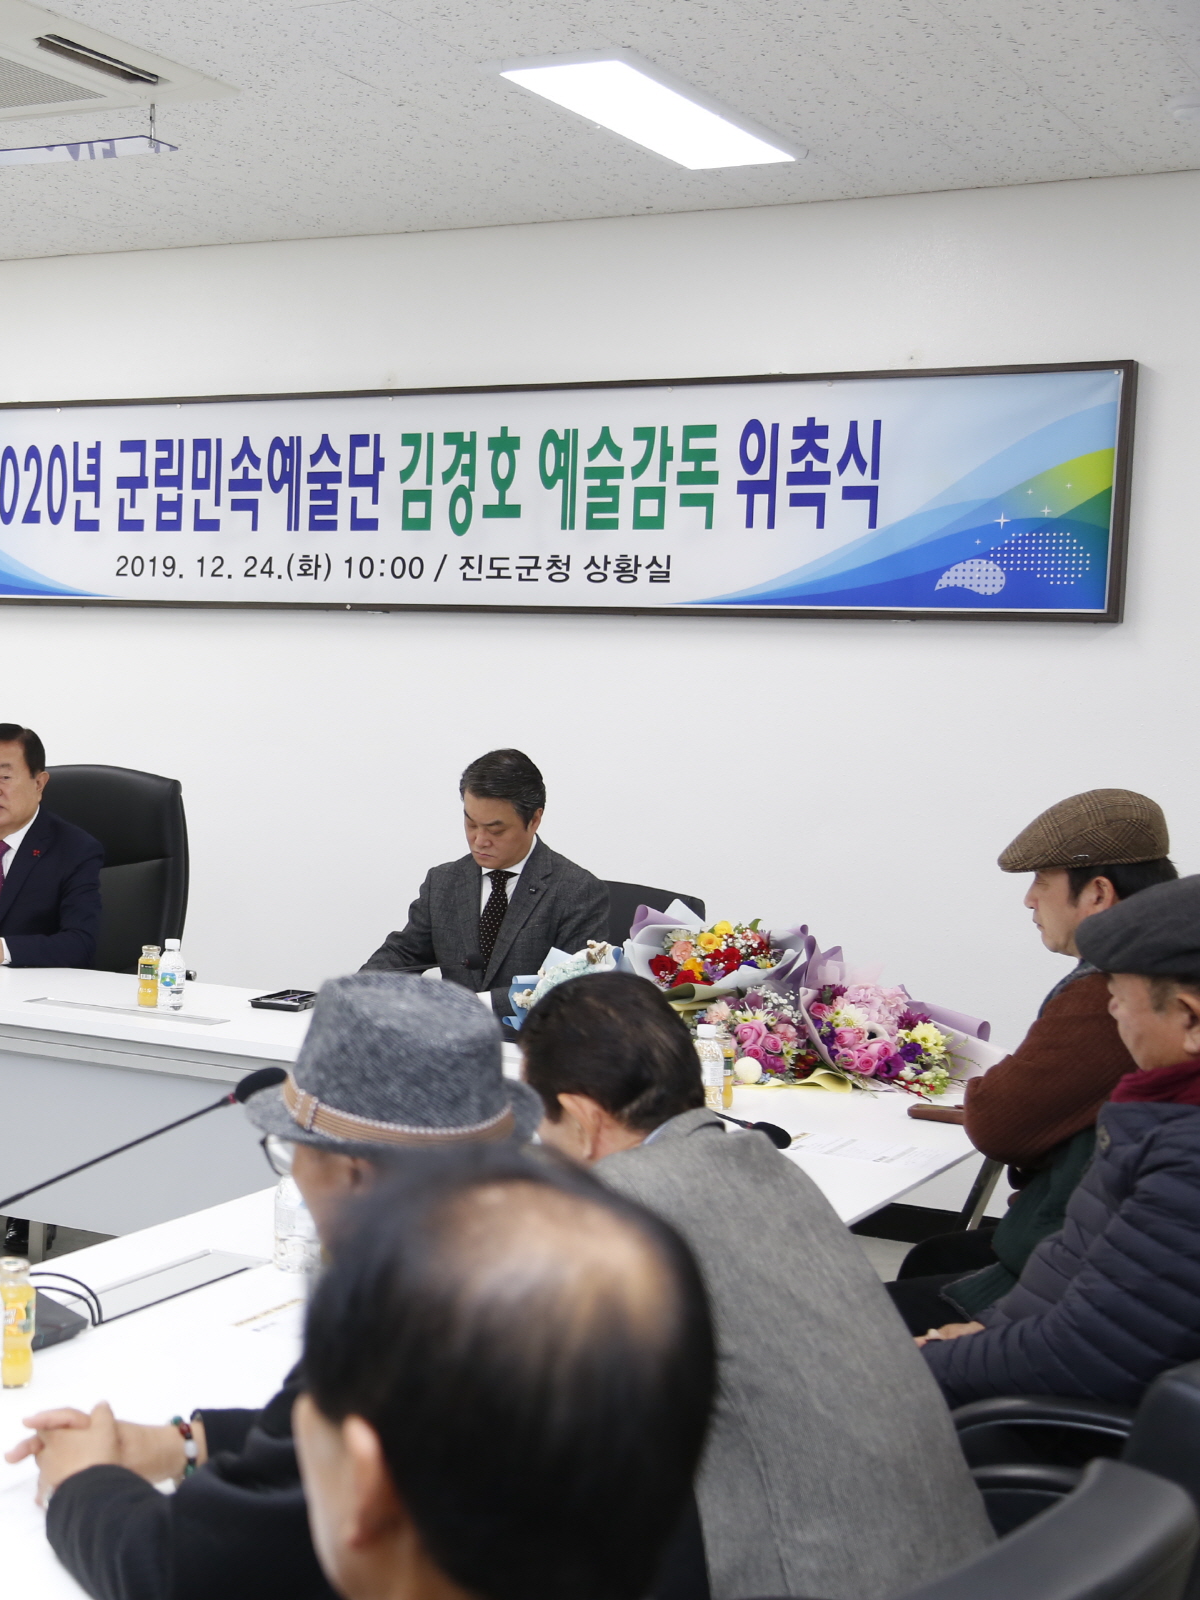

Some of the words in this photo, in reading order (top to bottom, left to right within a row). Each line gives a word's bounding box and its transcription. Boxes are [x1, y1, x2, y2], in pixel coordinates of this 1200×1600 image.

[116, 433, 386, 533] 군립민속예술단
[399, 426, 522, 538] 김경호
[538, 425, 720, 532] 예술감독
[736, 417, 883, 531] 위촉식
[115, 555, 184, 579] 2019.
[197, 556, 233, 580] 12.
[344, 556, 425, 580] 10:00
[458, 554, 572, 584] 진도군청
[583, 554, 672, 584] 상황실
